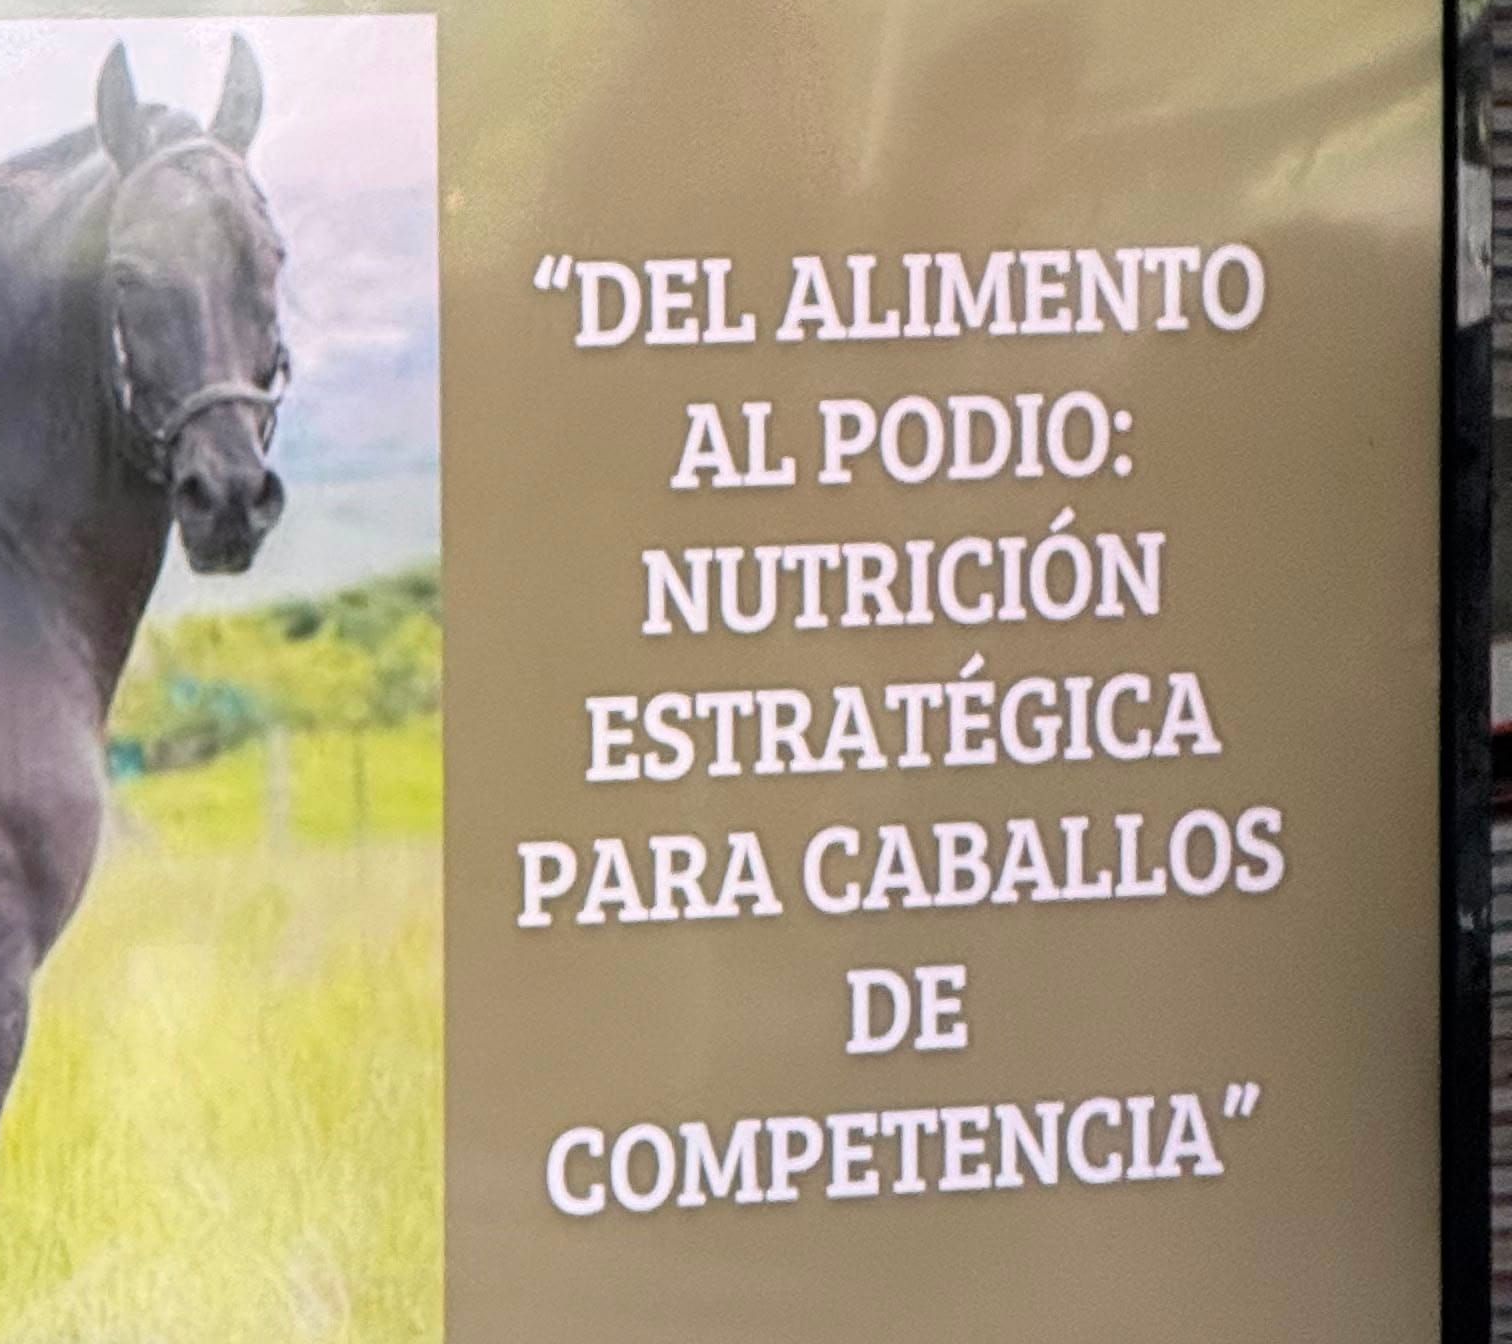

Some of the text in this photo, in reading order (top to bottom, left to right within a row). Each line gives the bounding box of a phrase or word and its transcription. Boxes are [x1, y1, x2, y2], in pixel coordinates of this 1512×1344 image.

[534, 244, 1264, 347] “DEL ALIMENTO
[671, 391, 1133, 489] AL PODIO:
[642, 507, 1165, 635] NUTRICIÓN
[585, 653, 1221, 782] ESTRATÉGICA
[517, 807, 1284, 927] PARA CABALLOS
[846, 965, 967, 1054] DE
[547, 1083, 1259, 1216] COMPETENCIA”
